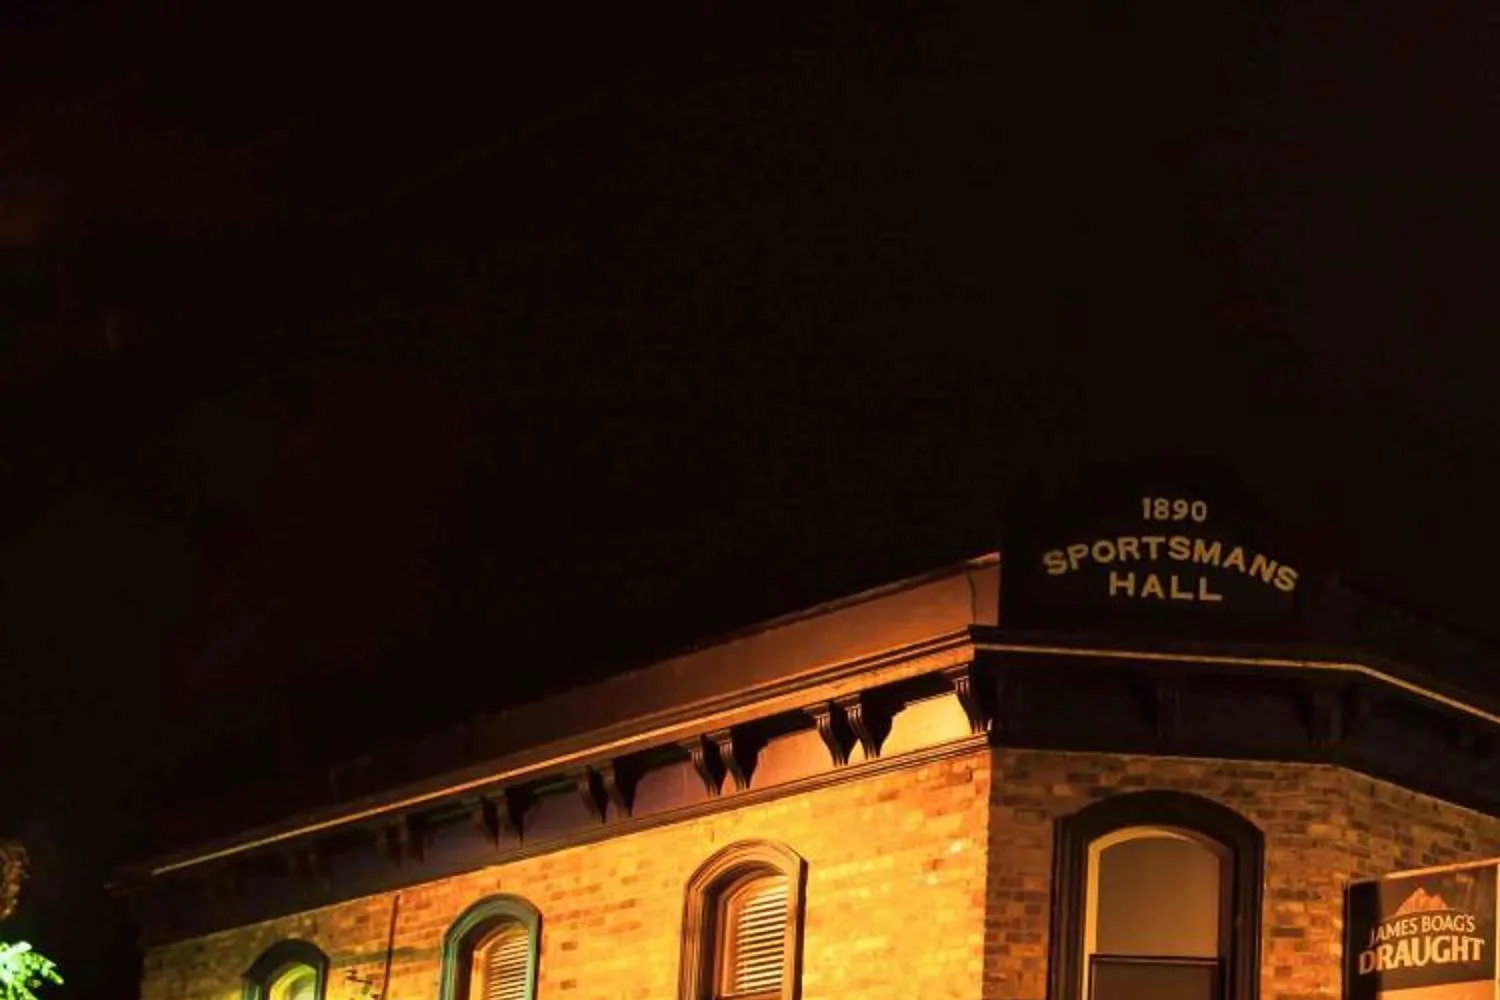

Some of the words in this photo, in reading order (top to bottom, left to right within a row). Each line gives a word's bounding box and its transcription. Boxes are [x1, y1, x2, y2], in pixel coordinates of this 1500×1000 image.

[1142, 497, 1207, 522] 1890
[1043, 536, 1298, 591] SPORTSMANS
[1109, 571, 1222, 601] HALL
[1369, 916, 1418, 948] JAMES
[1421, 913, 1476, 934] BOAG'S
[1359, 934, 1485, 975] DRAUGHT
